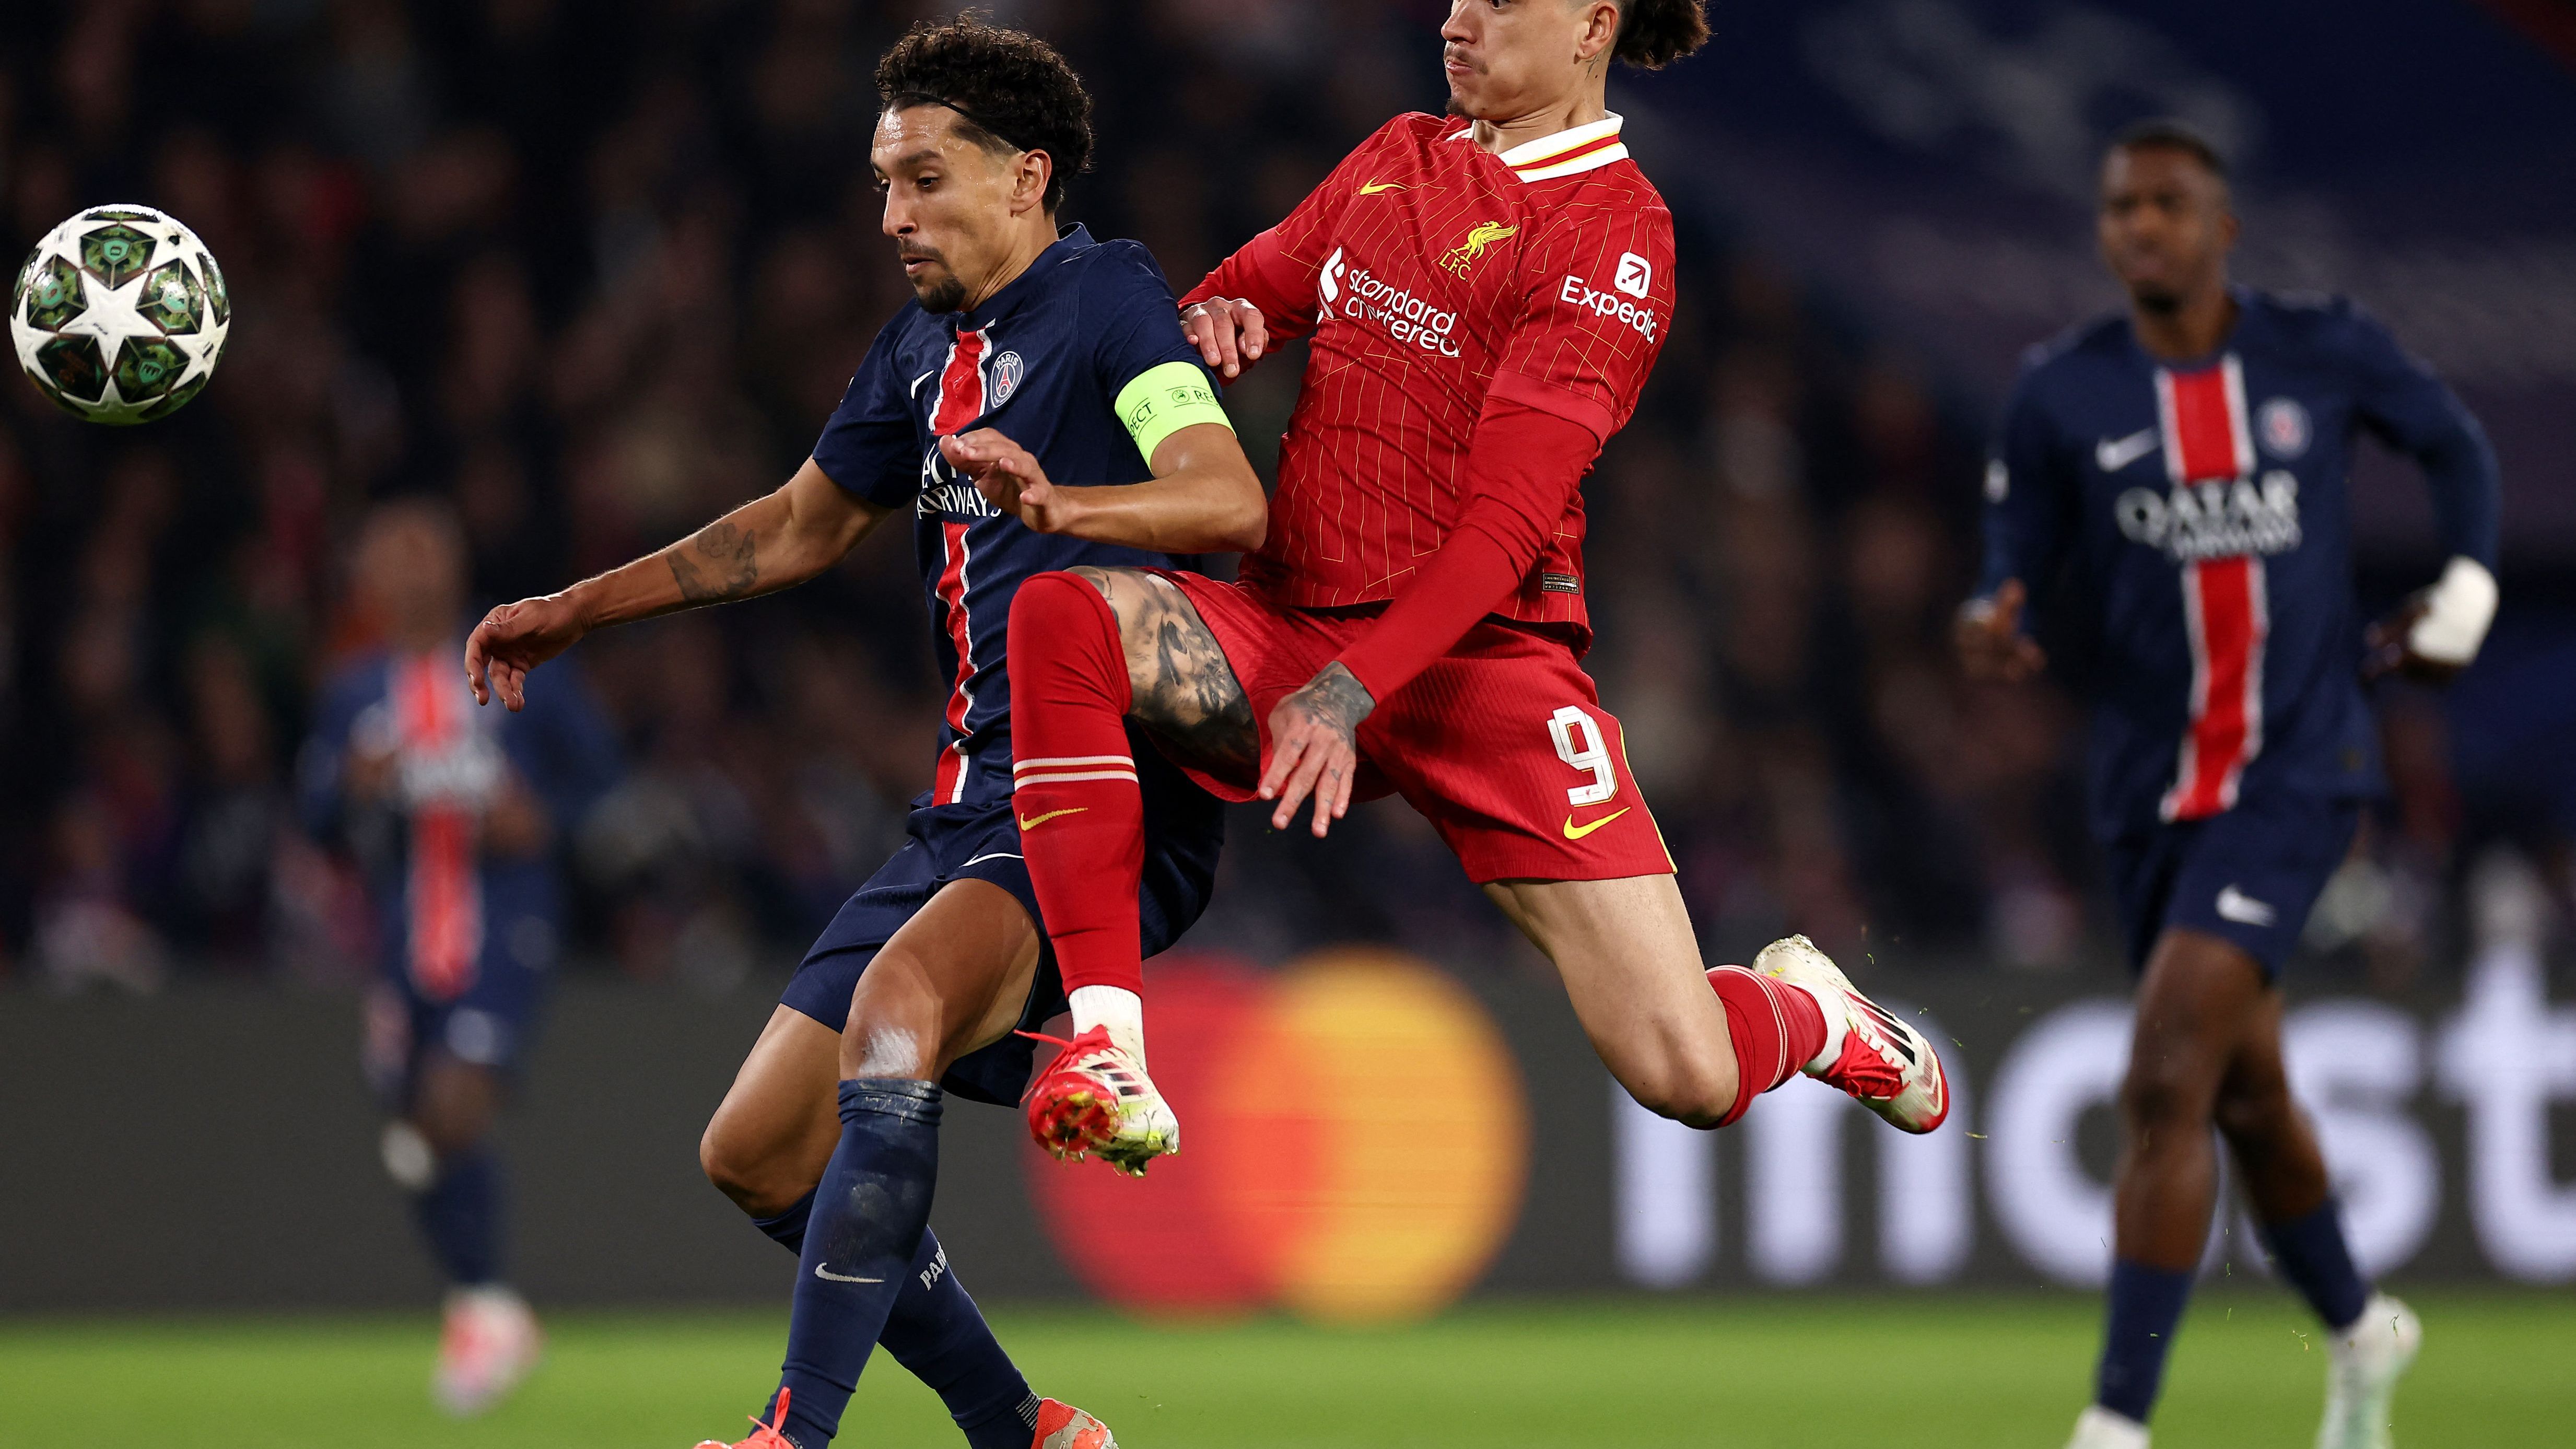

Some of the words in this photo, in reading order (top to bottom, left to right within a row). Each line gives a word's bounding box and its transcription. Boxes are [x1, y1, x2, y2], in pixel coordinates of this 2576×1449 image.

[1349, 269, 1457, 335] standard
[996, 354, 1018, 370] PARIS
[2113, 470, 2300, 550] QATAR
[1547, 705, 1618, 807] 9
